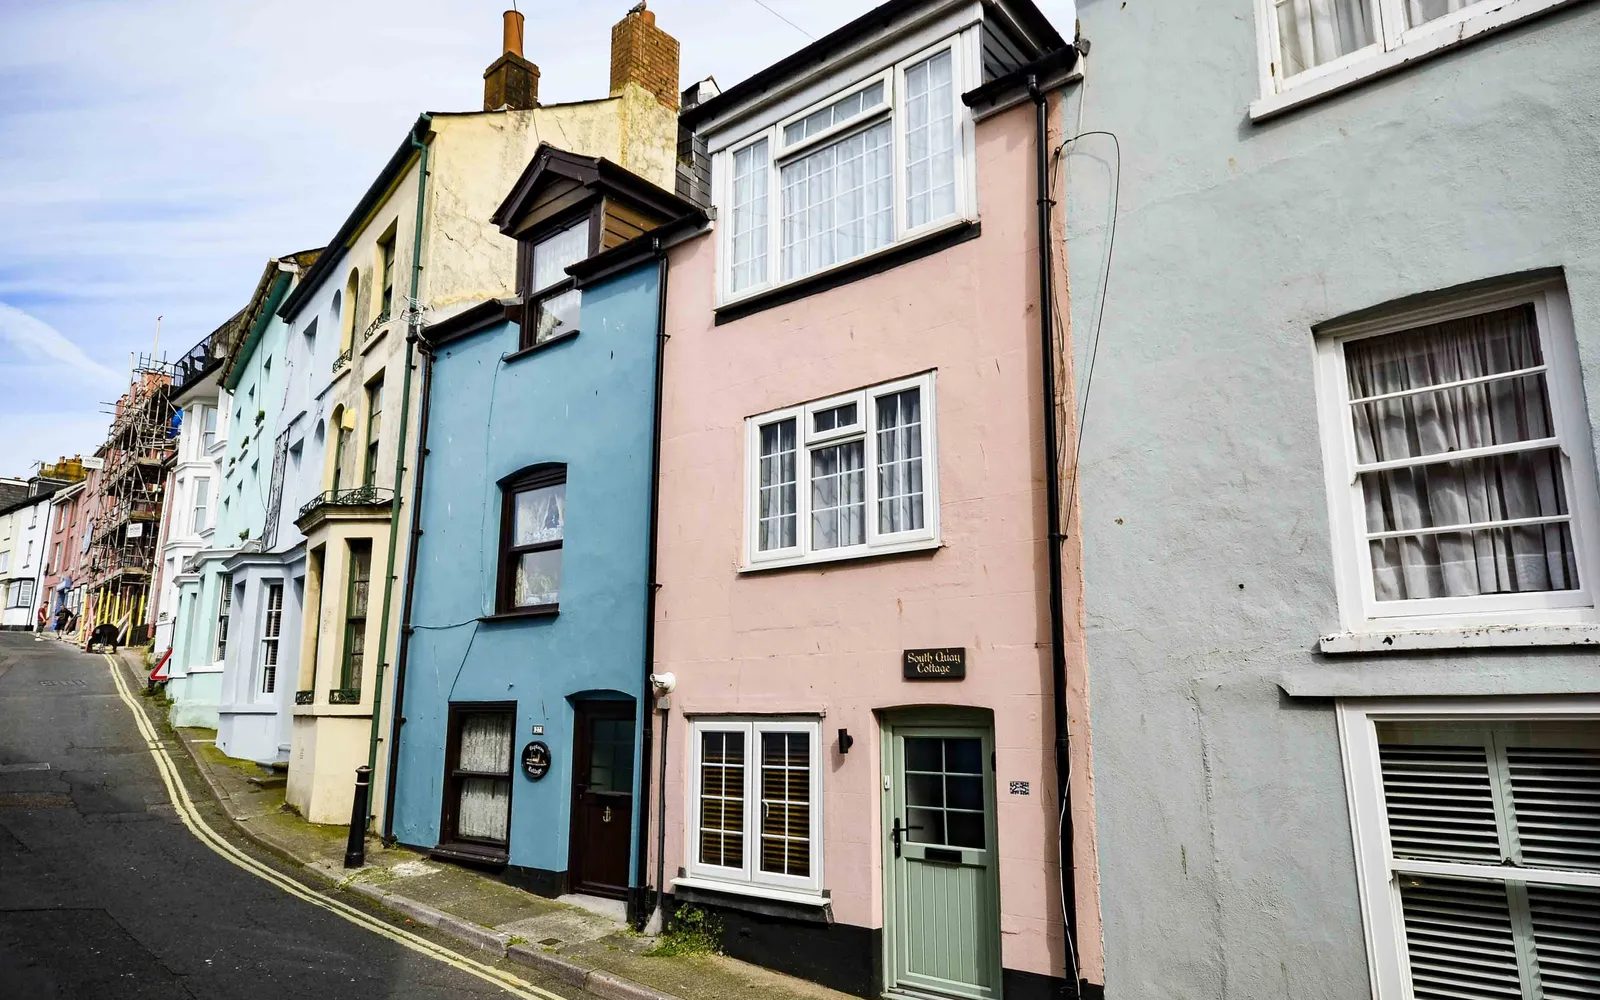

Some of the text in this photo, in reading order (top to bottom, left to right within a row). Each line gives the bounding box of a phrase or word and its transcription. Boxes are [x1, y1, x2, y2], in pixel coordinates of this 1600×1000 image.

[907, 651, 961, 664] South Quay
[916, 662, 951, 675] Cottage
